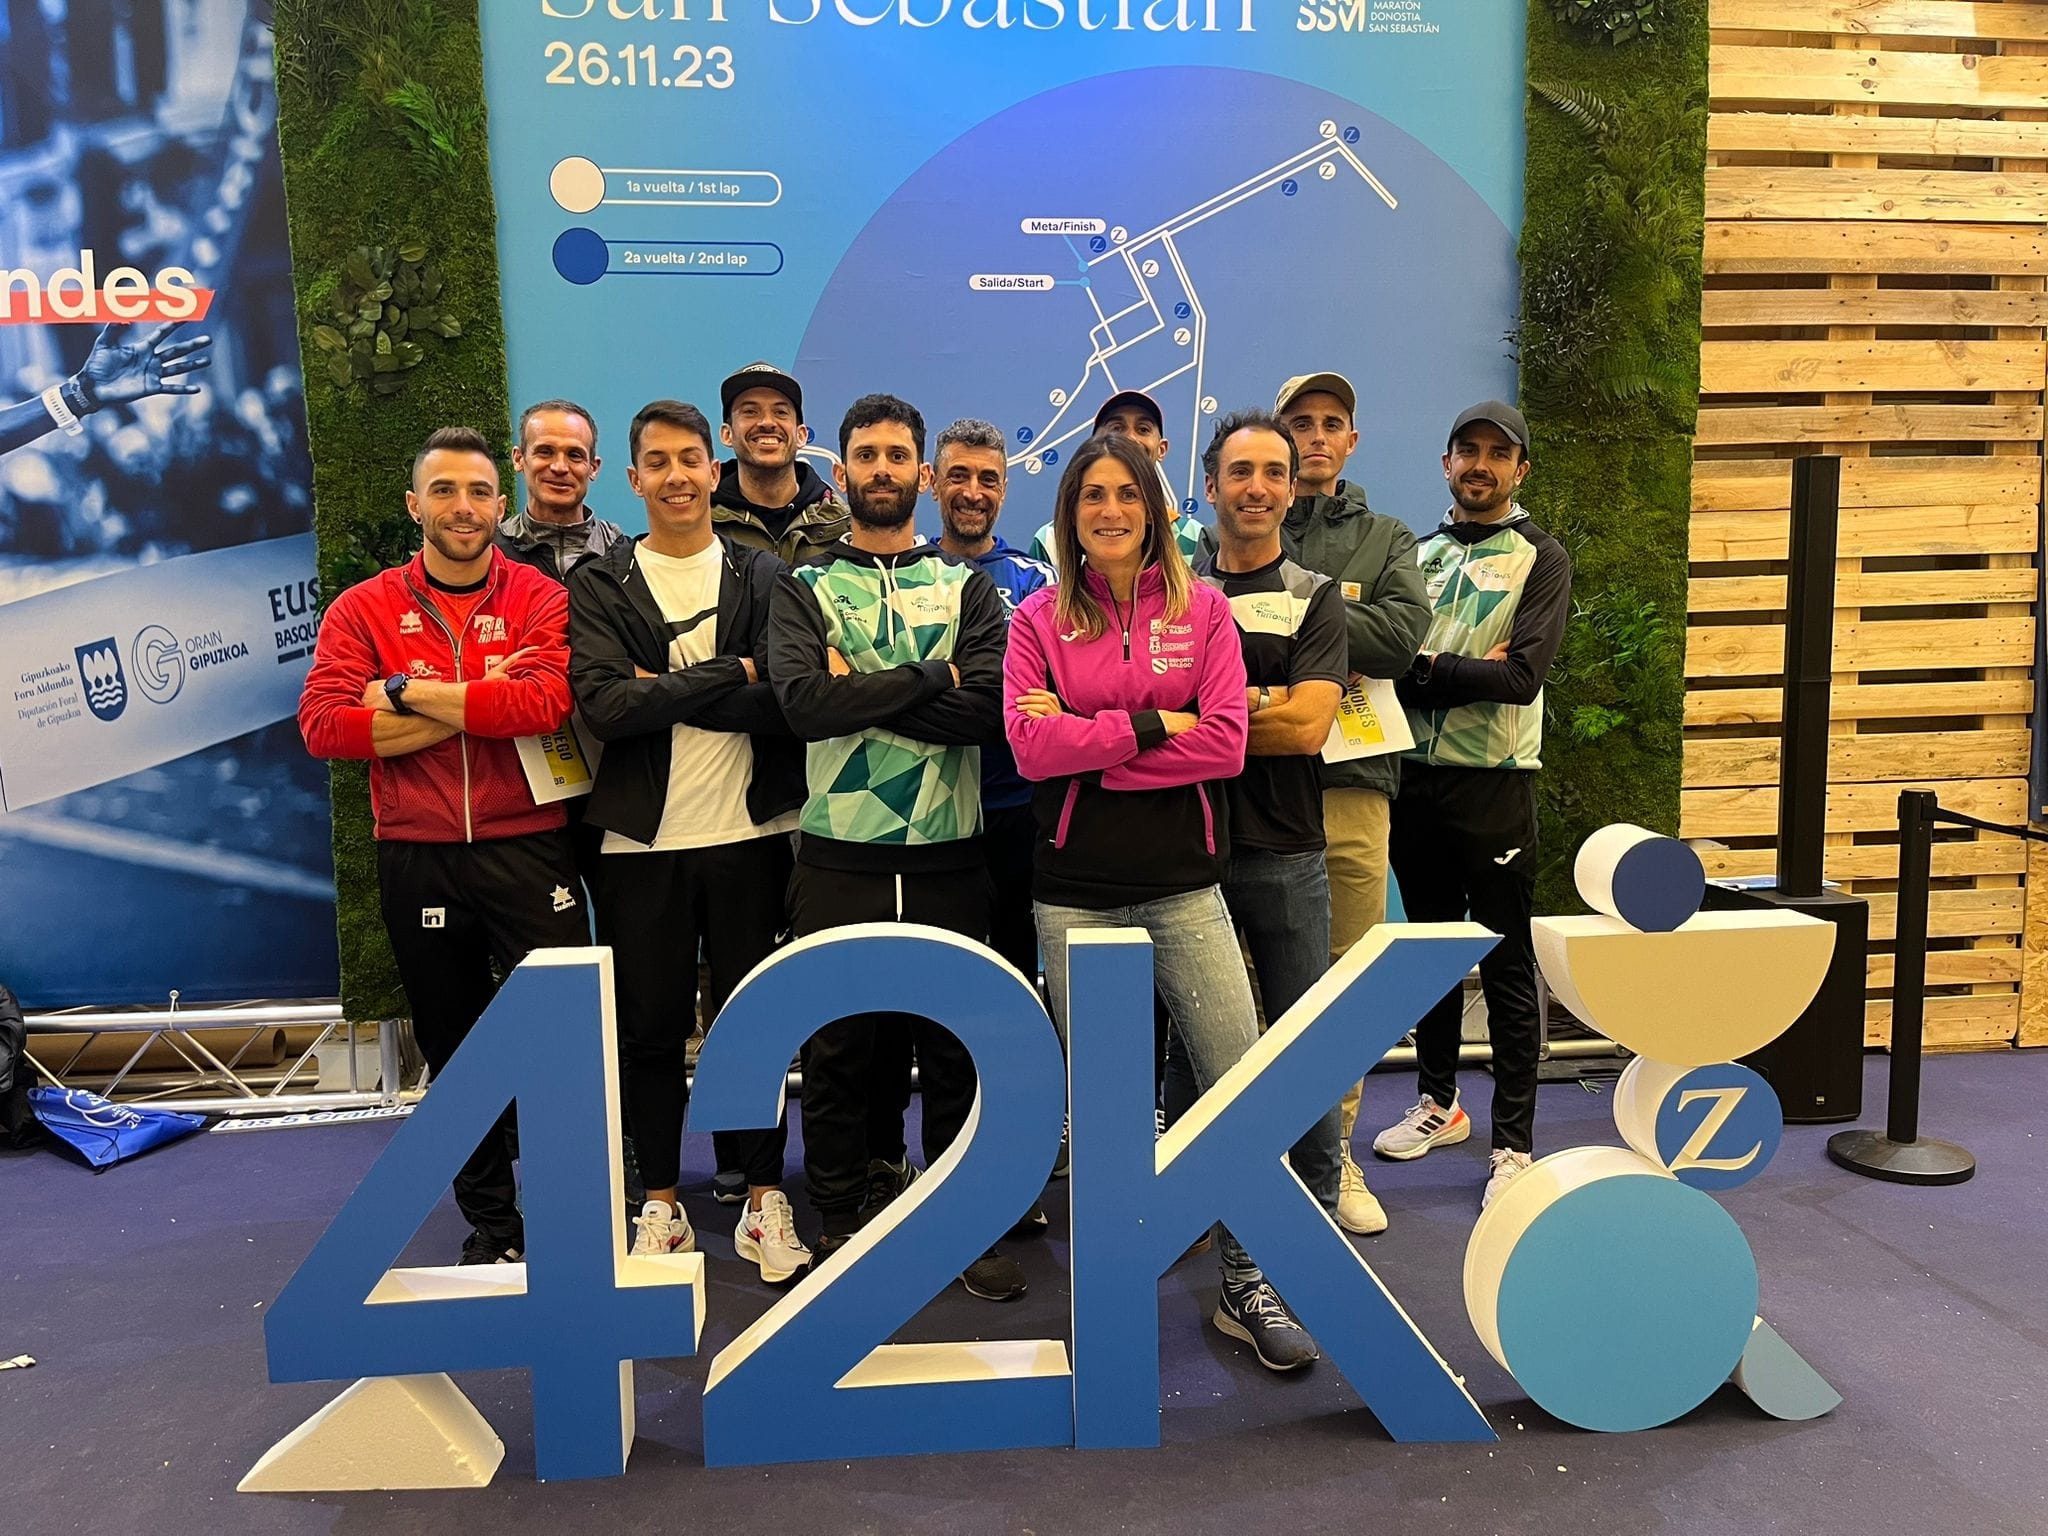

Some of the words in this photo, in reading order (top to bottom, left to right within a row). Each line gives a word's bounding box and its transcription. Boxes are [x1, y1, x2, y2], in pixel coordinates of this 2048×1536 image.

[1370, 12, 1421, 21] DONOSTIA
[1368, 23, 1388, 33] SAN
[1389, 23, 1440, 33] SEBASTIÁN
[544, 41, 735, 89] 26.11.23
[626, 181, 640, 193] 1a
[643, 182, 685, 194] vuelta
[697, 182, 716, 194] 1st
[719, 183, 740, 195] lap
[1031, 221, 1096, 232] Meta/Finish
[624, 252, 640, 264] 2a
[643, 252, 686, 264] vuelta
[698, 253, 724, 265] 2nd
[726, 253, 748, 267] lap
[979, 277, 1044, 288] Salida/Start
[186, 630, 223, 653] ORAIN
[275, 620, 322, 649] BASQU
[190, 642, 249, 671] GIPUZKOA
[21, 662, 71, 684] Gipuzkoako
[14, 691, 35, 701] Foru
[36, 677, 74, 696] Aldundia
[58, 693, 79, 708] Foral
[1340, 700, 1355, 716] 186
[1347, 683, 1378, 729] MOISÉS
[37, 718, 47, 729] de
[47, 708, 82, 727] Gipuzkoa
[552, 729, 574, 761] IEGO
[1667, 1087, 1763, 1172] Z
[265, 923, 1502, 1480] 42K
